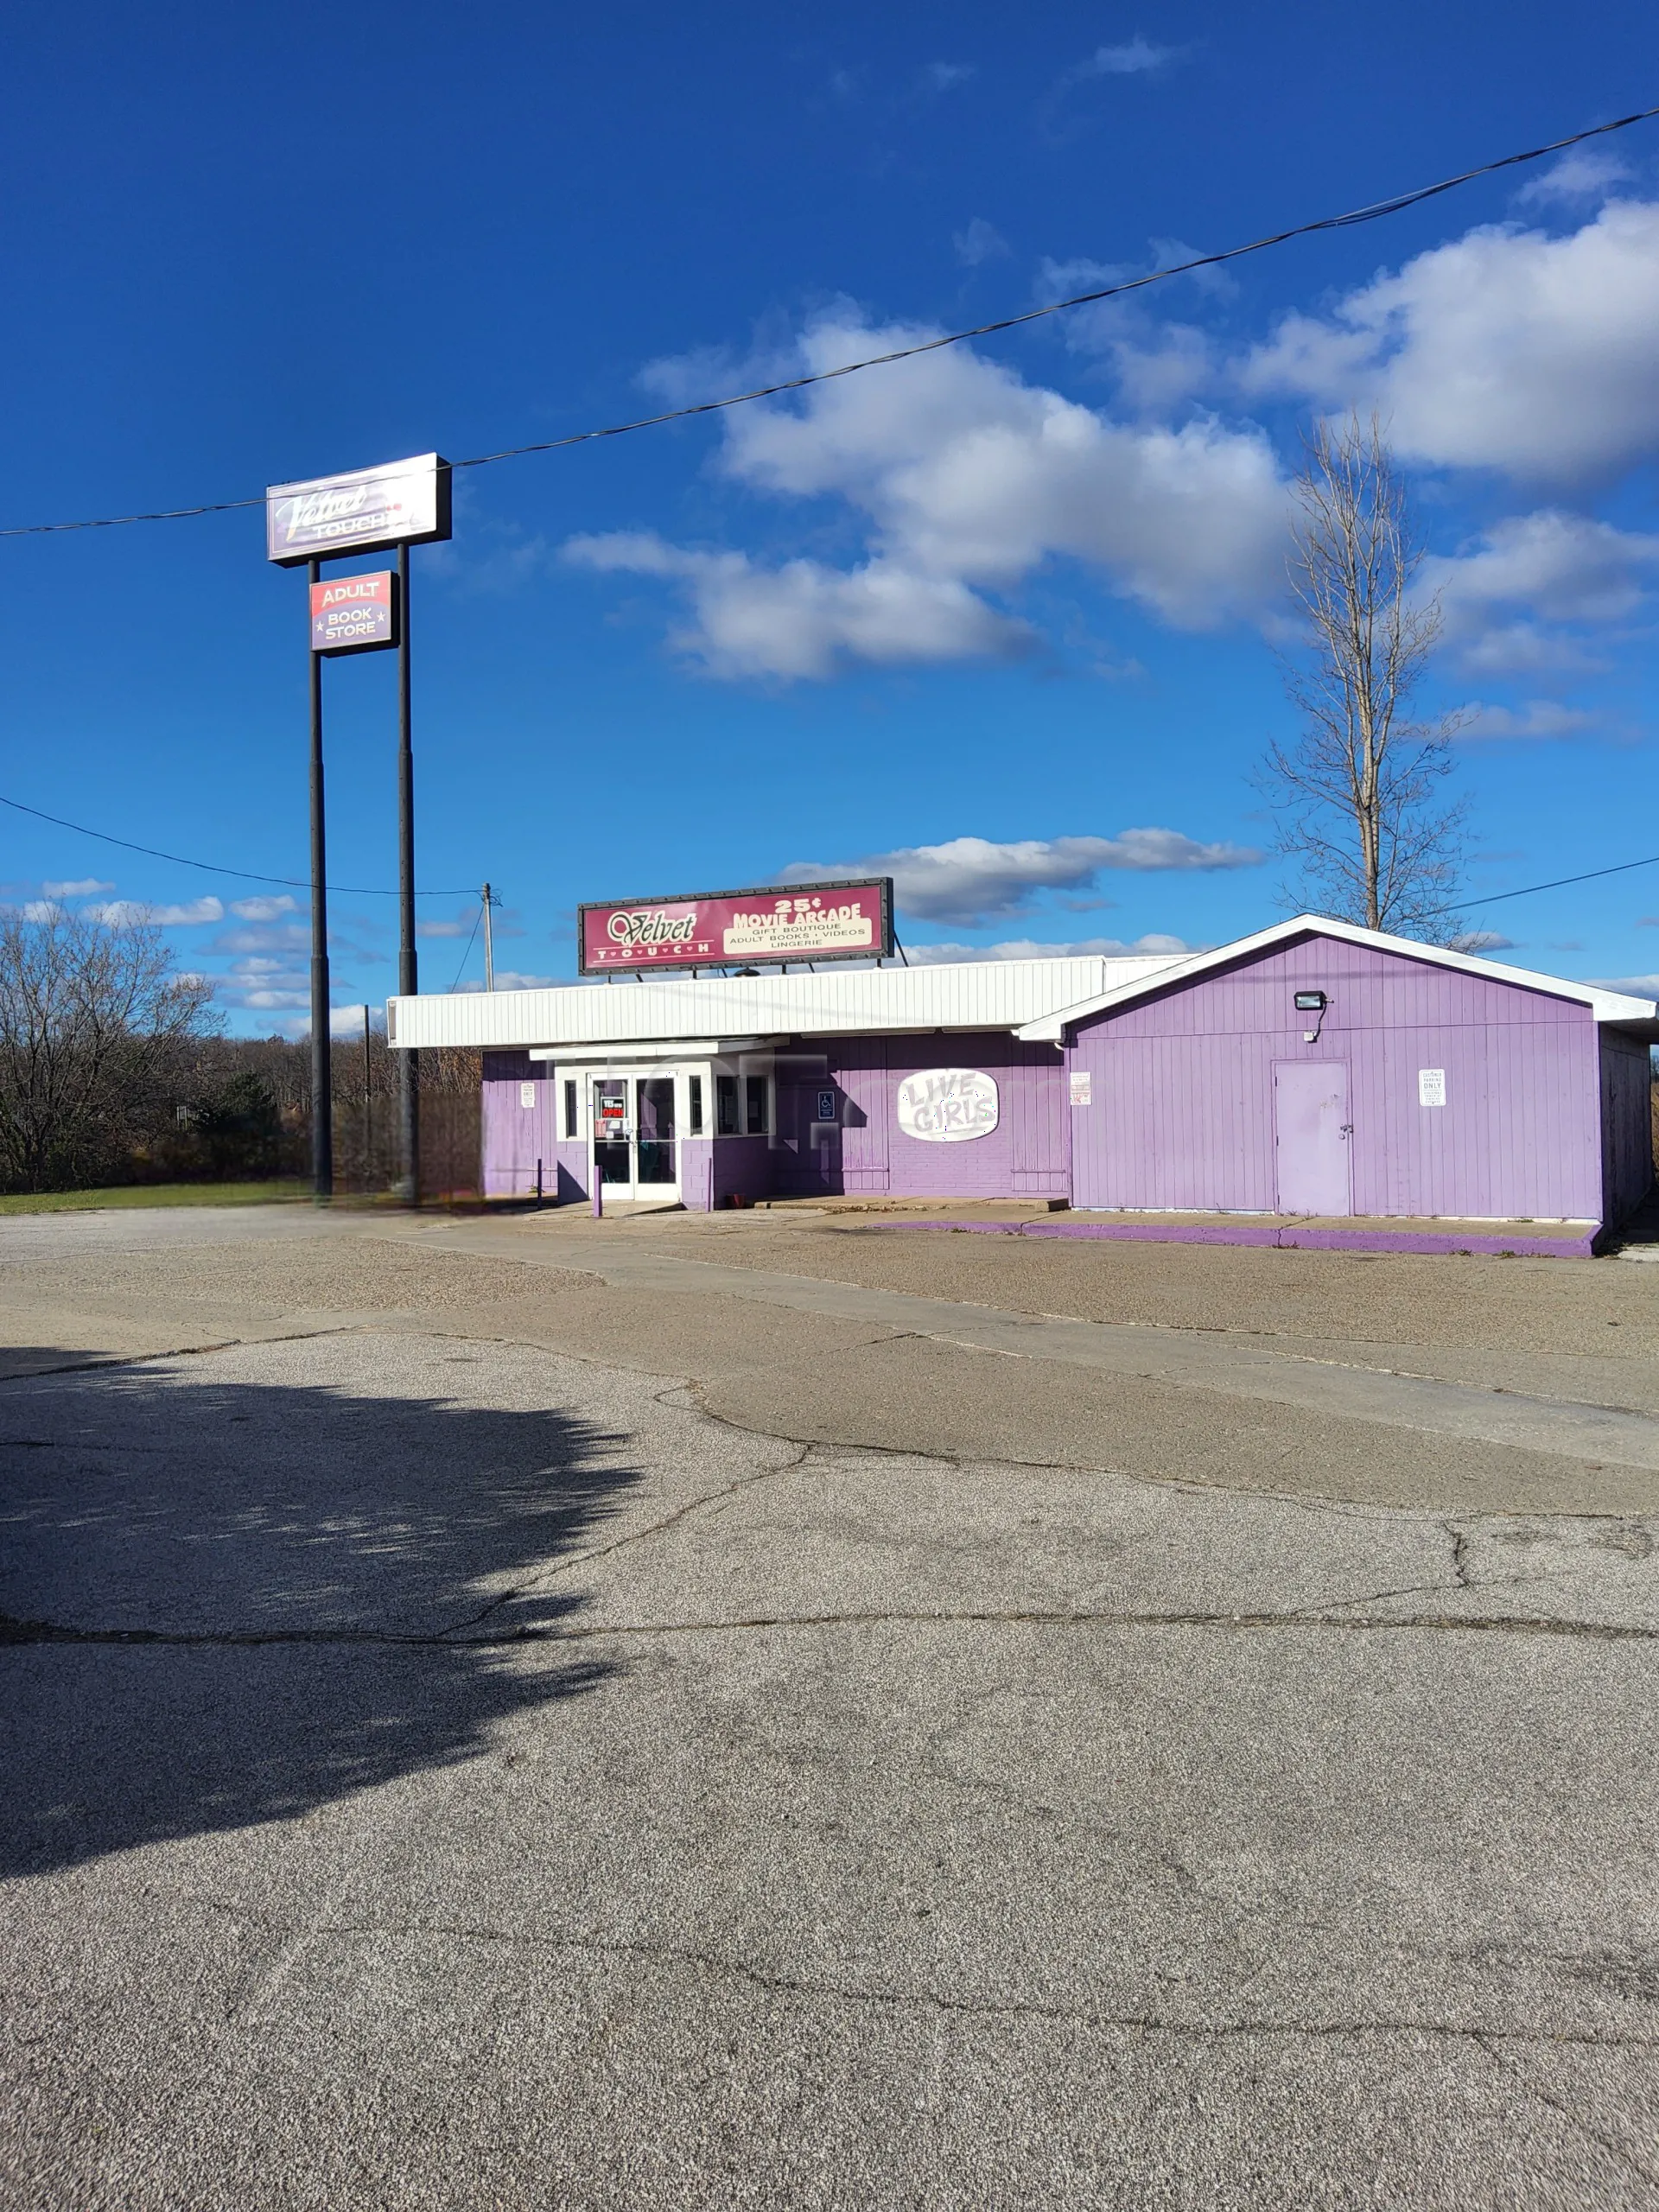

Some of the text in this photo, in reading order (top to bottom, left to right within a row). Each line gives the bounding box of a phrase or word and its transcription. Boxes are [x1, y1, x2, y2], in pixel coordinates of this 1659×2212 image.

[322, 582, 379, 607] ADULT
[328, 607, 372, 626] BOOK
[326, 622, 375, 639] STORE
[775, 897, 822, 914] 25¢
[734, 902, 861, 929] MOVIE ARCADE
[607, 910, 698, 948] Velvet
[783, 923, 842, 933] BOUTIQUE
[823, 929, 866, 938] VIDEOS
[771, 939, 823, 949] LINGERIE
[906, 1072, 976, 1108] LIVE
[603, 1109, 624, 1117] OPEN
[913, 1096, 995, 1133] GIRLS
